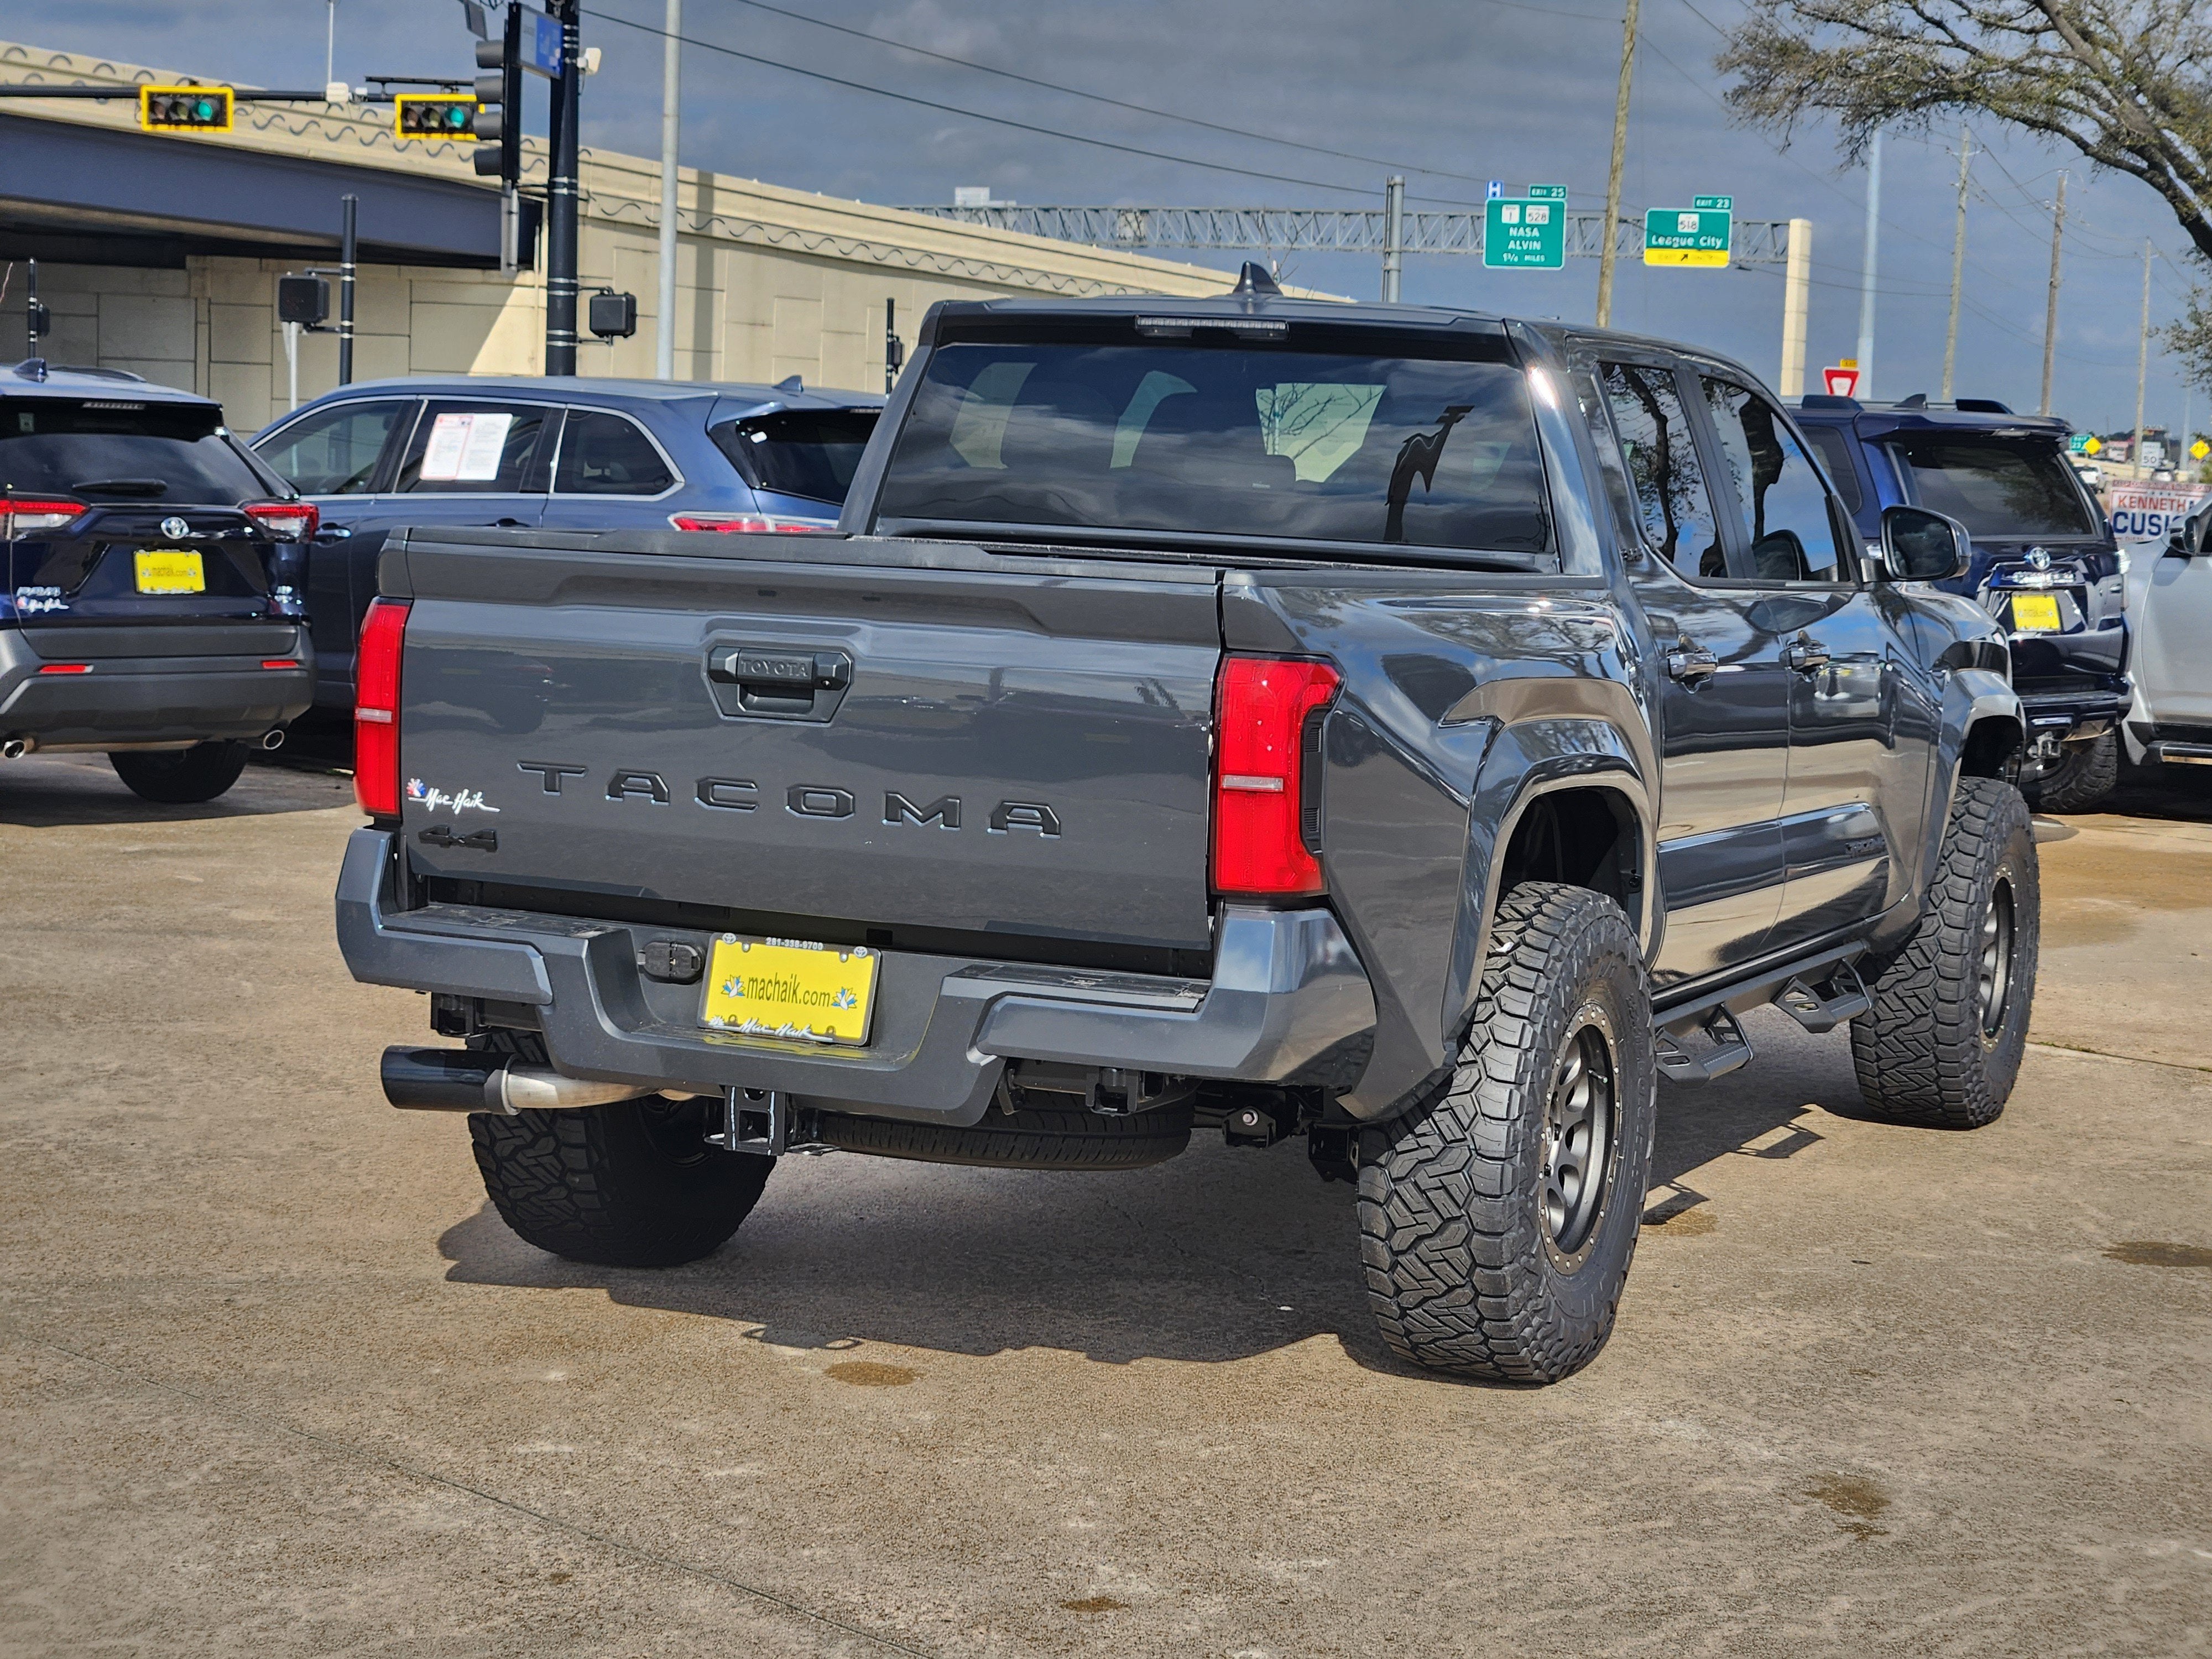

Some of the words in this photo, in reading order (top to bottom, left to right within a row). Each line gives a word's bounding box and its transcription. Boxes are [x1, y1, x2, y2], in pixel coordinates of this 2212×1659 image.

[1551, 187, 1564, 197] 25
[1716, 199, 1730, 208] 23
[1528, 212, 1547, 222] 528
[1509, 227, 1540, 237] NASA
[1679, 221, 1697, 229] 518
[1508, 240, 1541, 250] ALVIN
[1651, 234, 1695, 248] League
[1699, 236, 1723, 249] City
[2118, 495, 2186, 513] KENNETH
[2113, 512, 2183, 536] CUSI
[740, 659, 808, 677] TOYOTA
[426, 787, 453, 812] Mac
[452, 789, 500, 815] Haik
[518, 760, 1061, 839] TACOMA
[747, 972, 831, 1008] machaik.com
